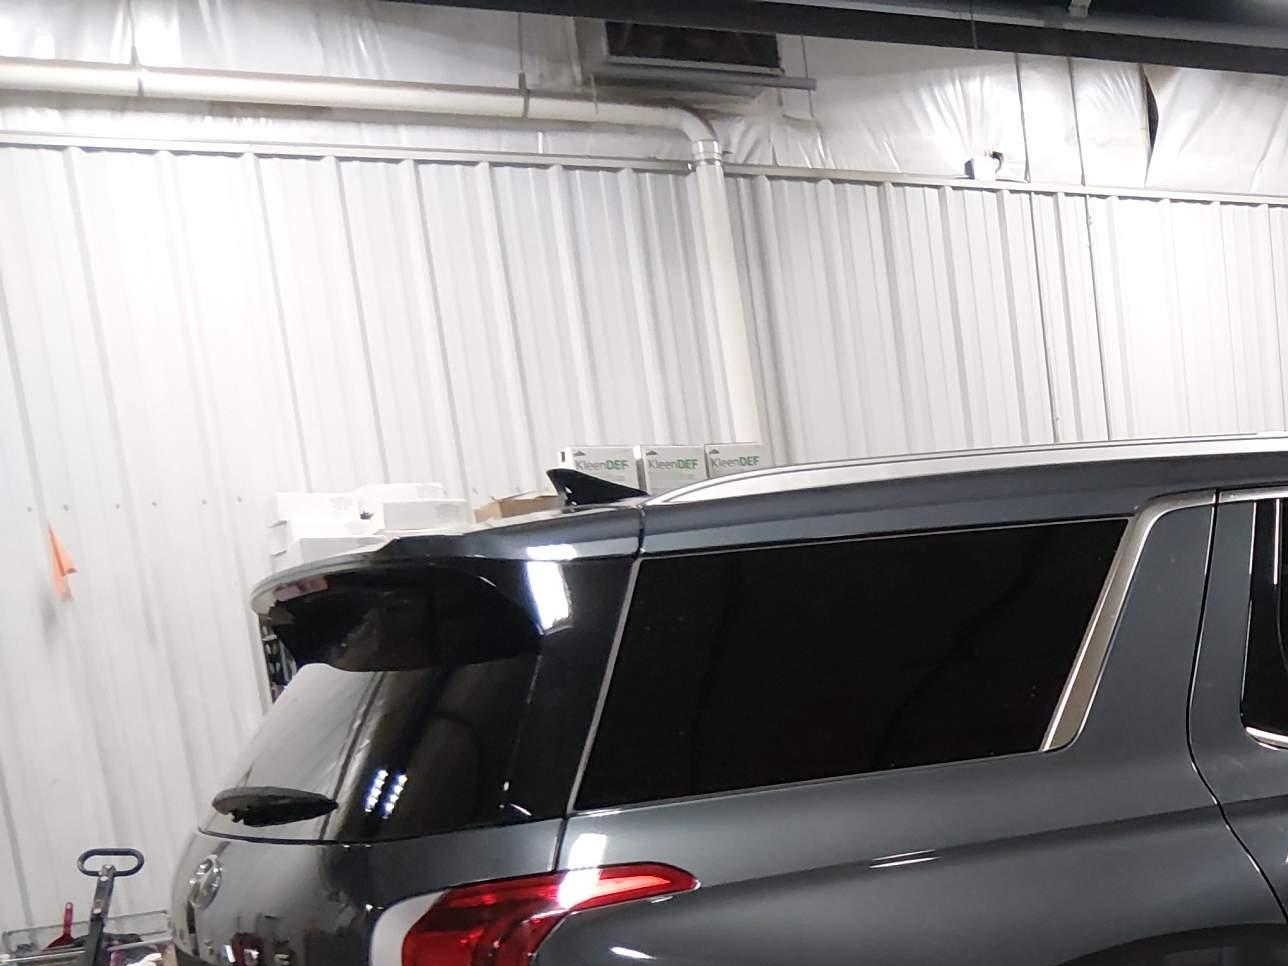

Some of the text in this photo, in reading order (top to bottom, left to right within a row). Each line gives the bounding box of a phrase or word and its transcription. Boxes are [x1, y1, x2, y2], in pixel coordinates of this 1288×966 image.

[575, 459, 628, 471] KleenDEF
[648, 458, 699, 470] KleenDEF
[710, 456, 760, 469] KleenDEF
